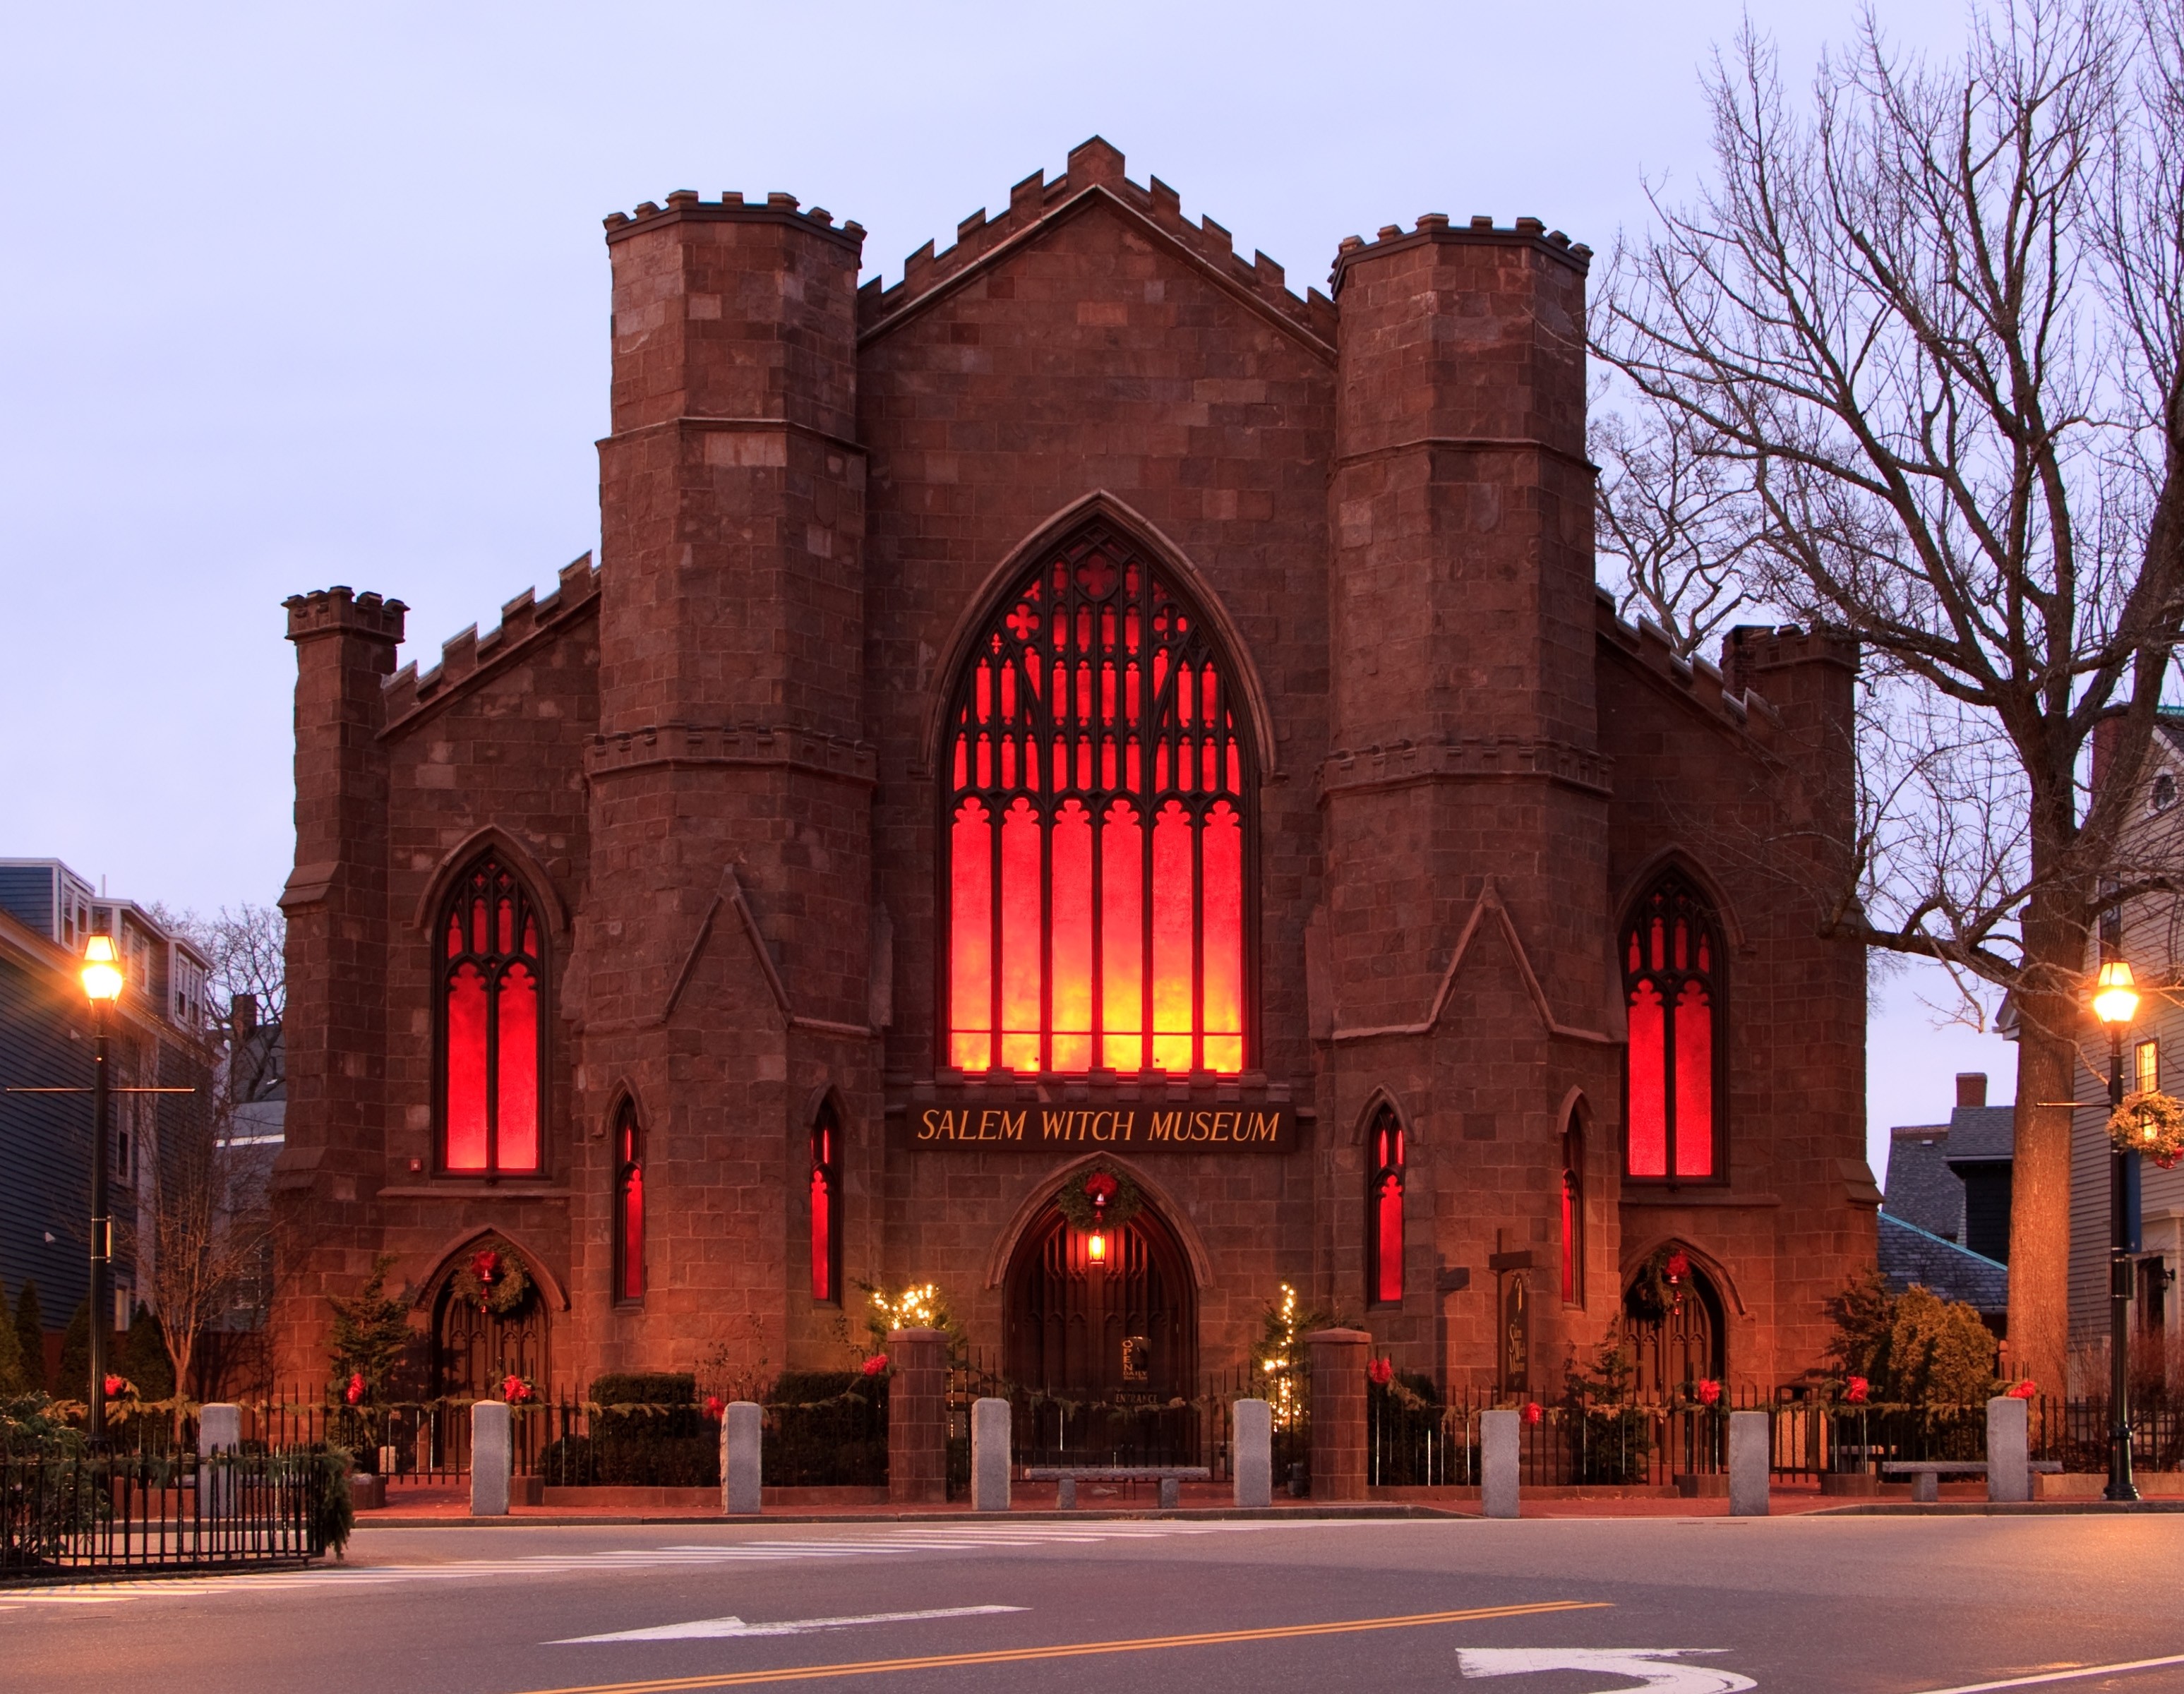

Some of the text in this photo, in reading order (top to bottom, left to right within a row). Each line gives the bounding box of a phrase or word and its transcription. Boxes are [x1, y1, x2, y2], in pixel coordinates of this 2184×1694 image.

[918, 1109, 1280, 1141] SALEM WITCH MUSEUM
[1122, 1340, 1133, 1371] OPEN
